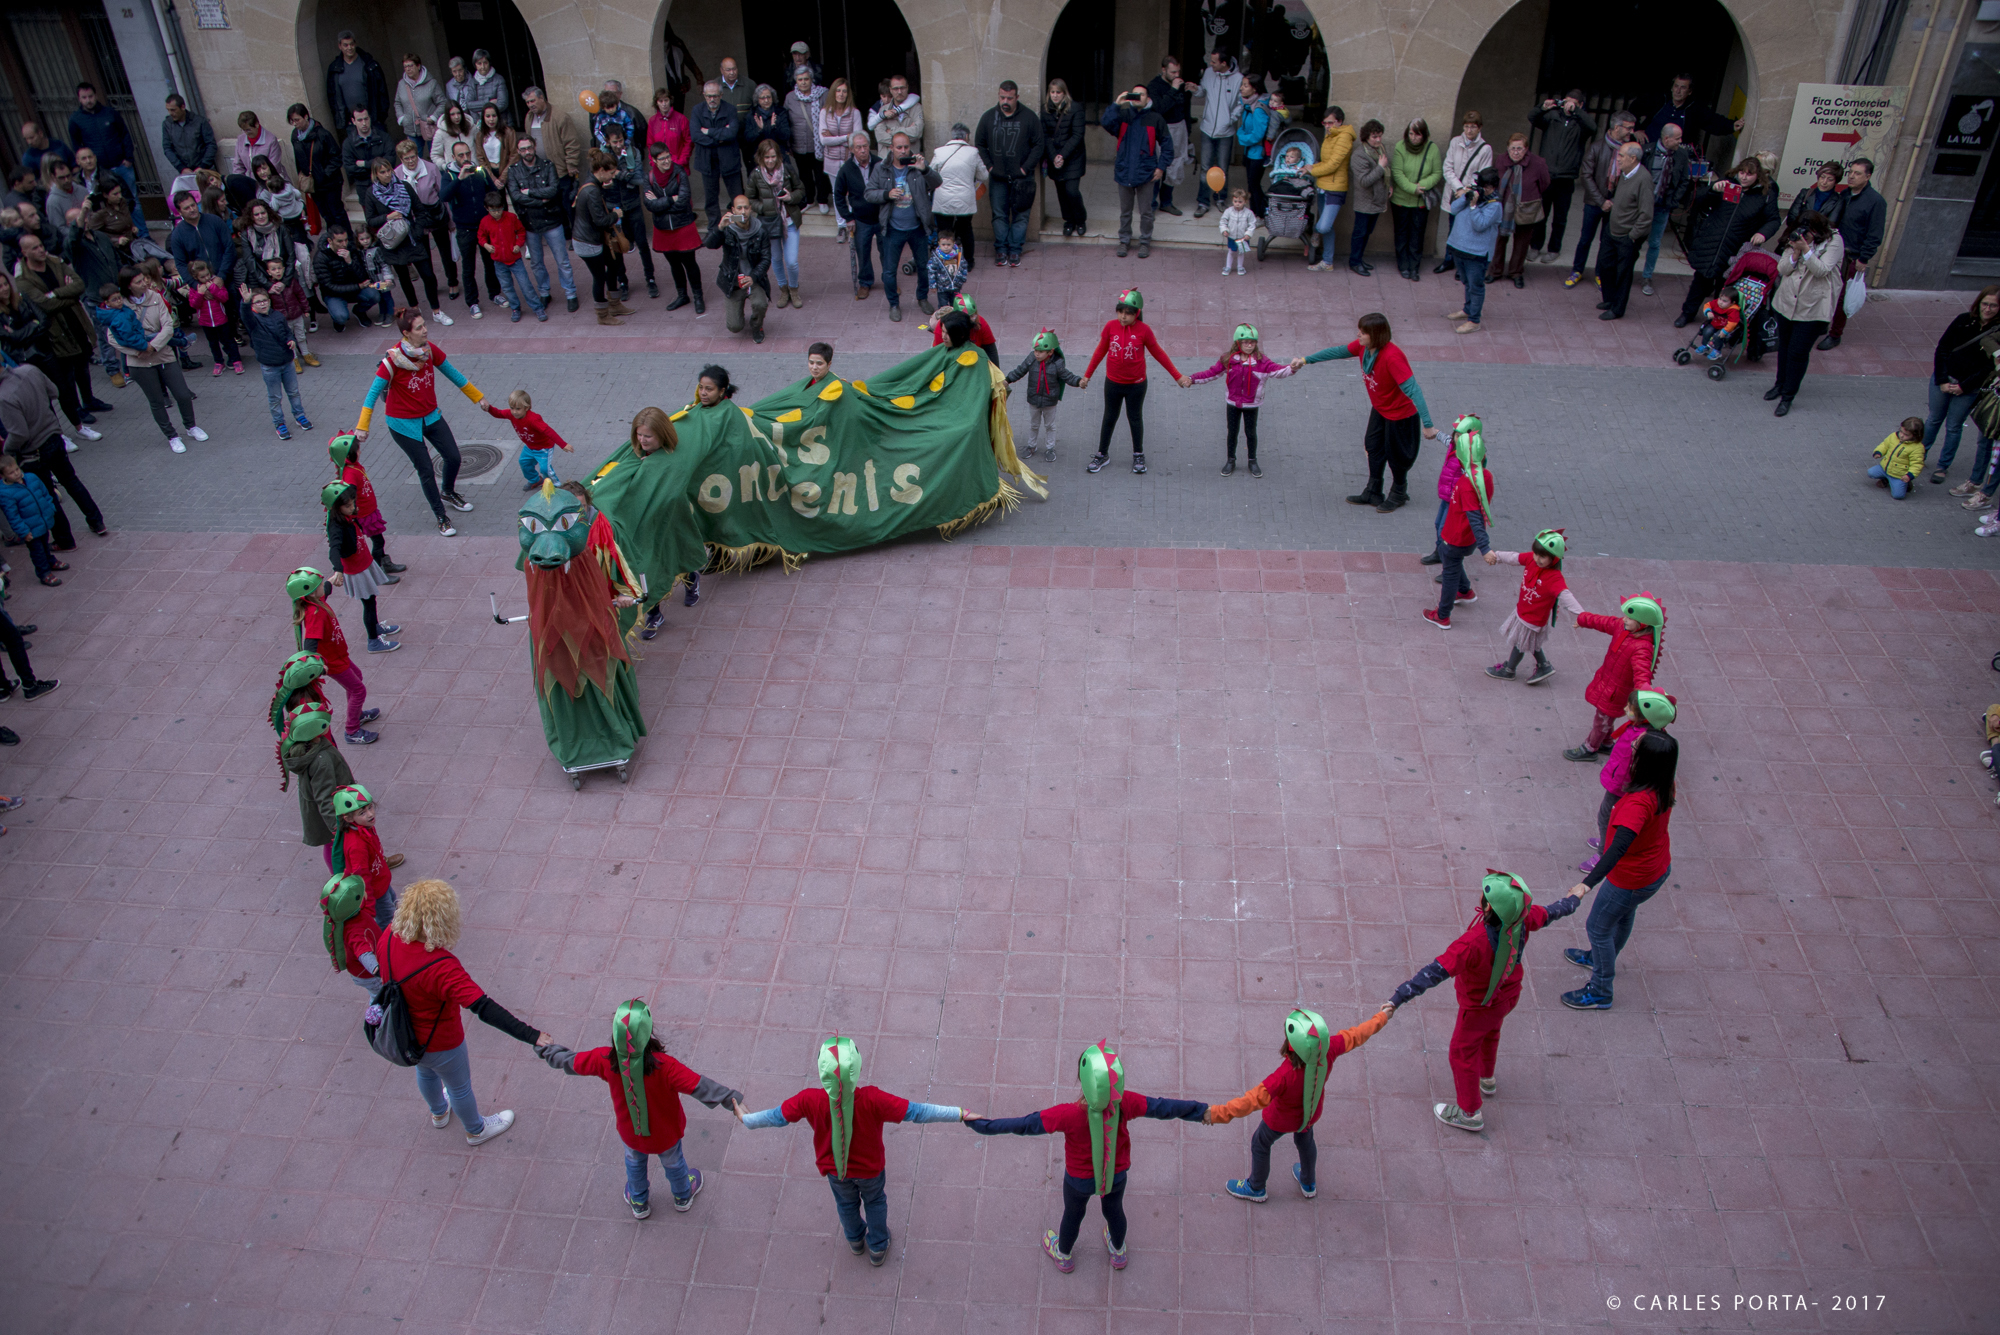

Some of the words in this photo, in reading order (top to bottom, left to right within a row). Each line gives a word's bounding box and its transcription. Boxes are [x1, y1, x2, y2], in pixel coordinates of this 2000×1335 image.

[1811, 96, 1832, 106] Fira
[1834, 98, 1891, 108] Comercial
[1814, 106, 1849, 116] Carrer
[1850, 108, 1883, 119] Josep
[1809, 116, 1849, 126] Anselm
[1851, 117, 1883, 127] Clavé
[1947, 134, 1959, 144] LA
[1961, 135, 1981, 145] VILA
[1804, 158, 1824, 167] Fira
[1793, 166, 1807, 175] de
